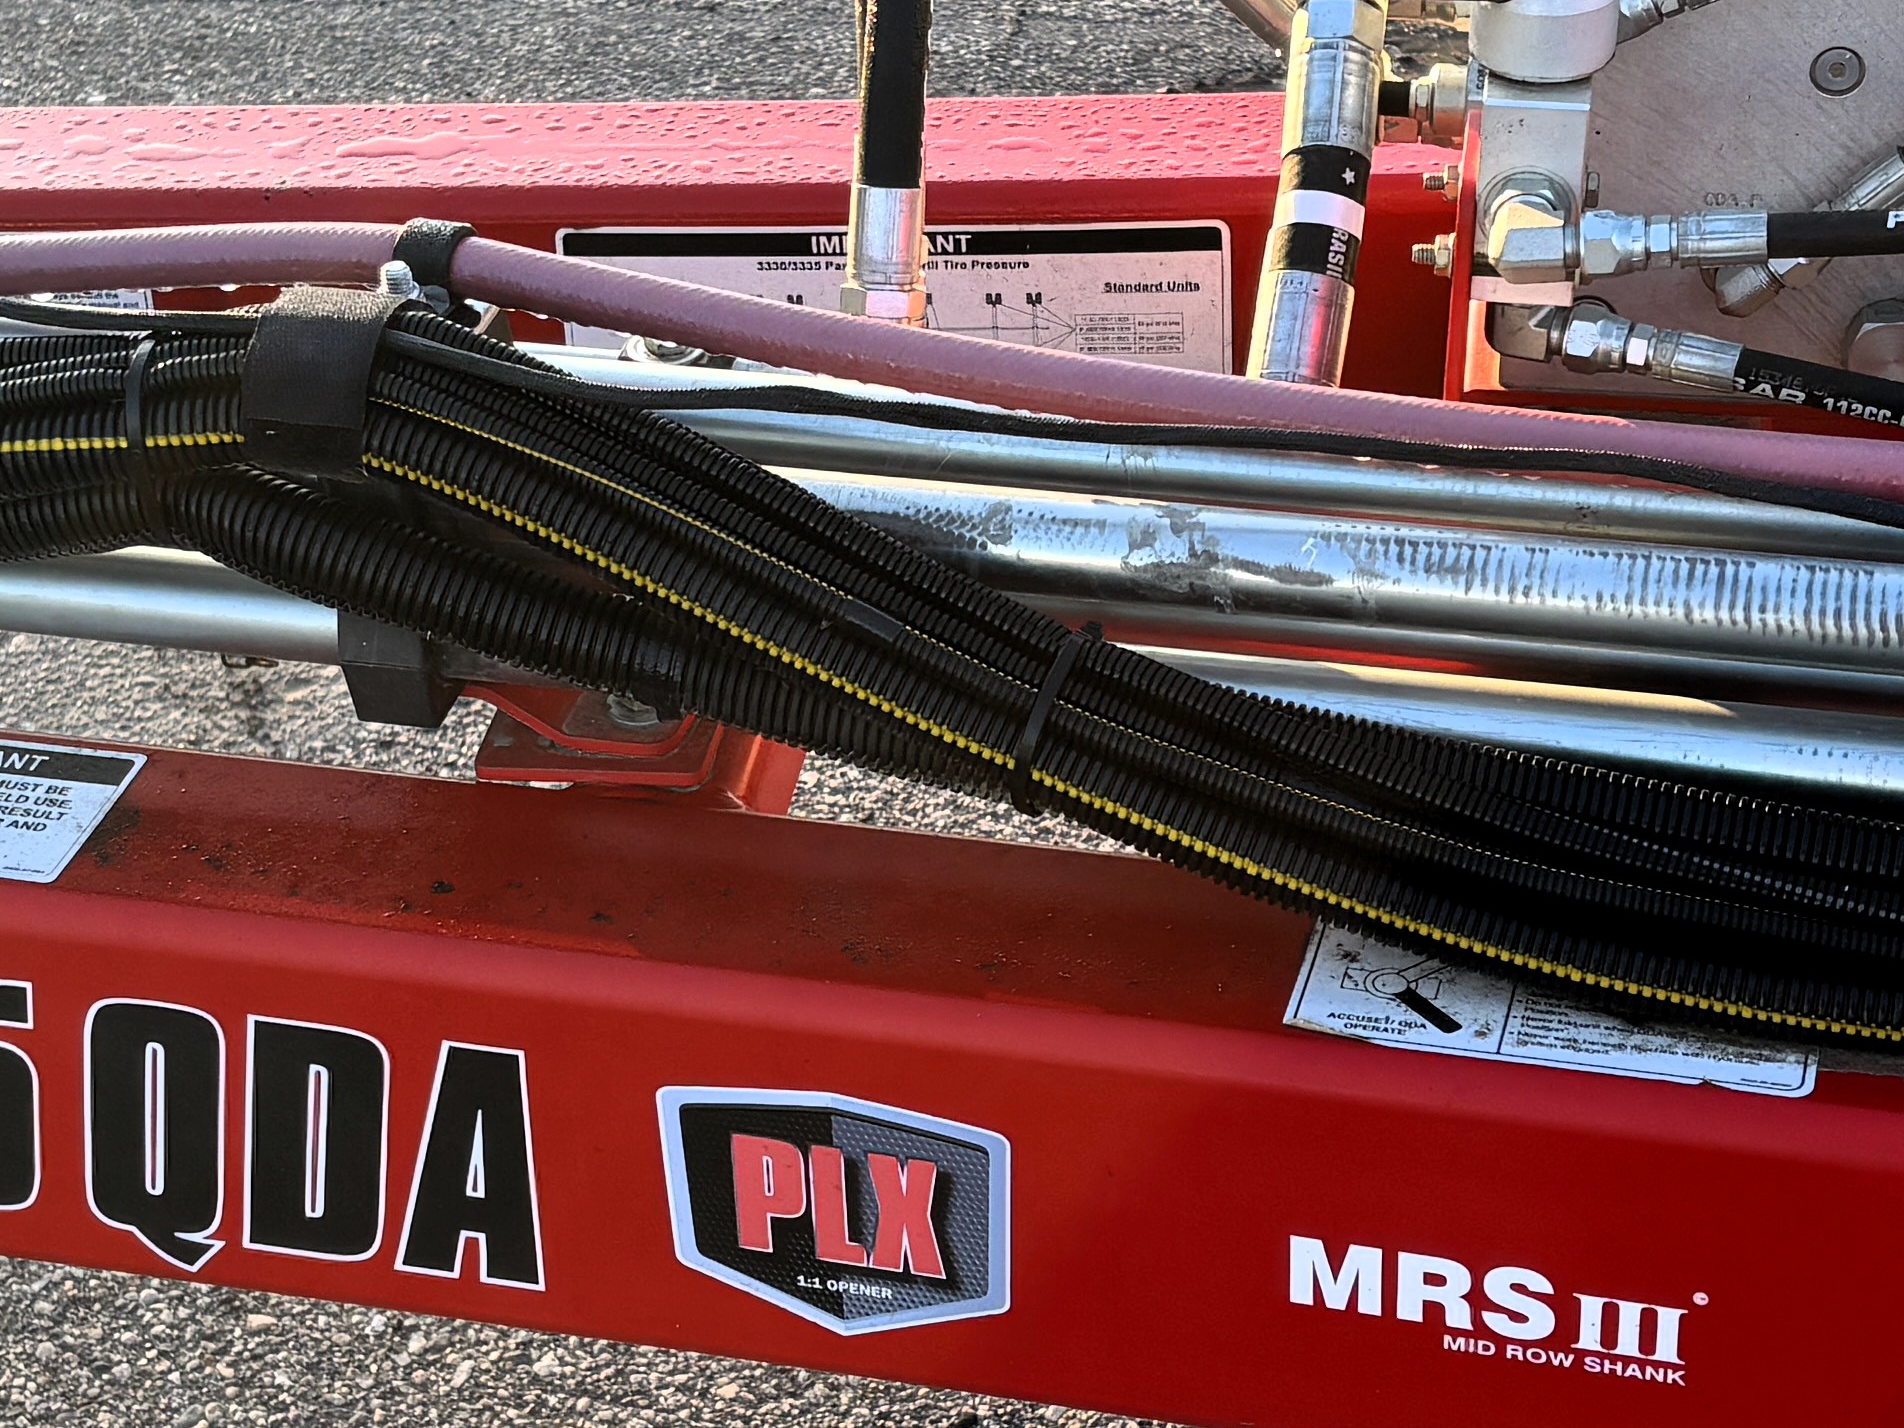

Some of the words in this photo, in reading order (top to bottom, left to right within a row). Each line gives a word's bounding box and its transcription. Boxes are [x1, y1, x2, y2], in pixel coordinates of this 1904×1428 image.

[811, 234, 972, 254] IMANT
[1103, 281, 1163, 294] Standard
[43, 785, 73, 796] BE
[30, 796, 77, 810] USE.
[5, 819, 50, 832] AND
[1344, 1022, 1408, 1036] OPERATE
[84, 996, 546, 1293] QDA
[730, 1133, 947, 1280] PLX
[796, 1274, 823, 1289] 1:1
[826, 1279, 893, 1300] OPENER
[1289, 1234, 1555, 1341] MRS
[1571, 1292, 1688, 1365] III
[1442, 1334, 1496, 1356] MID
[1506, 1345, 1575, 1368] ROW
[1583, 1356, 1686, 1386] SHANK
